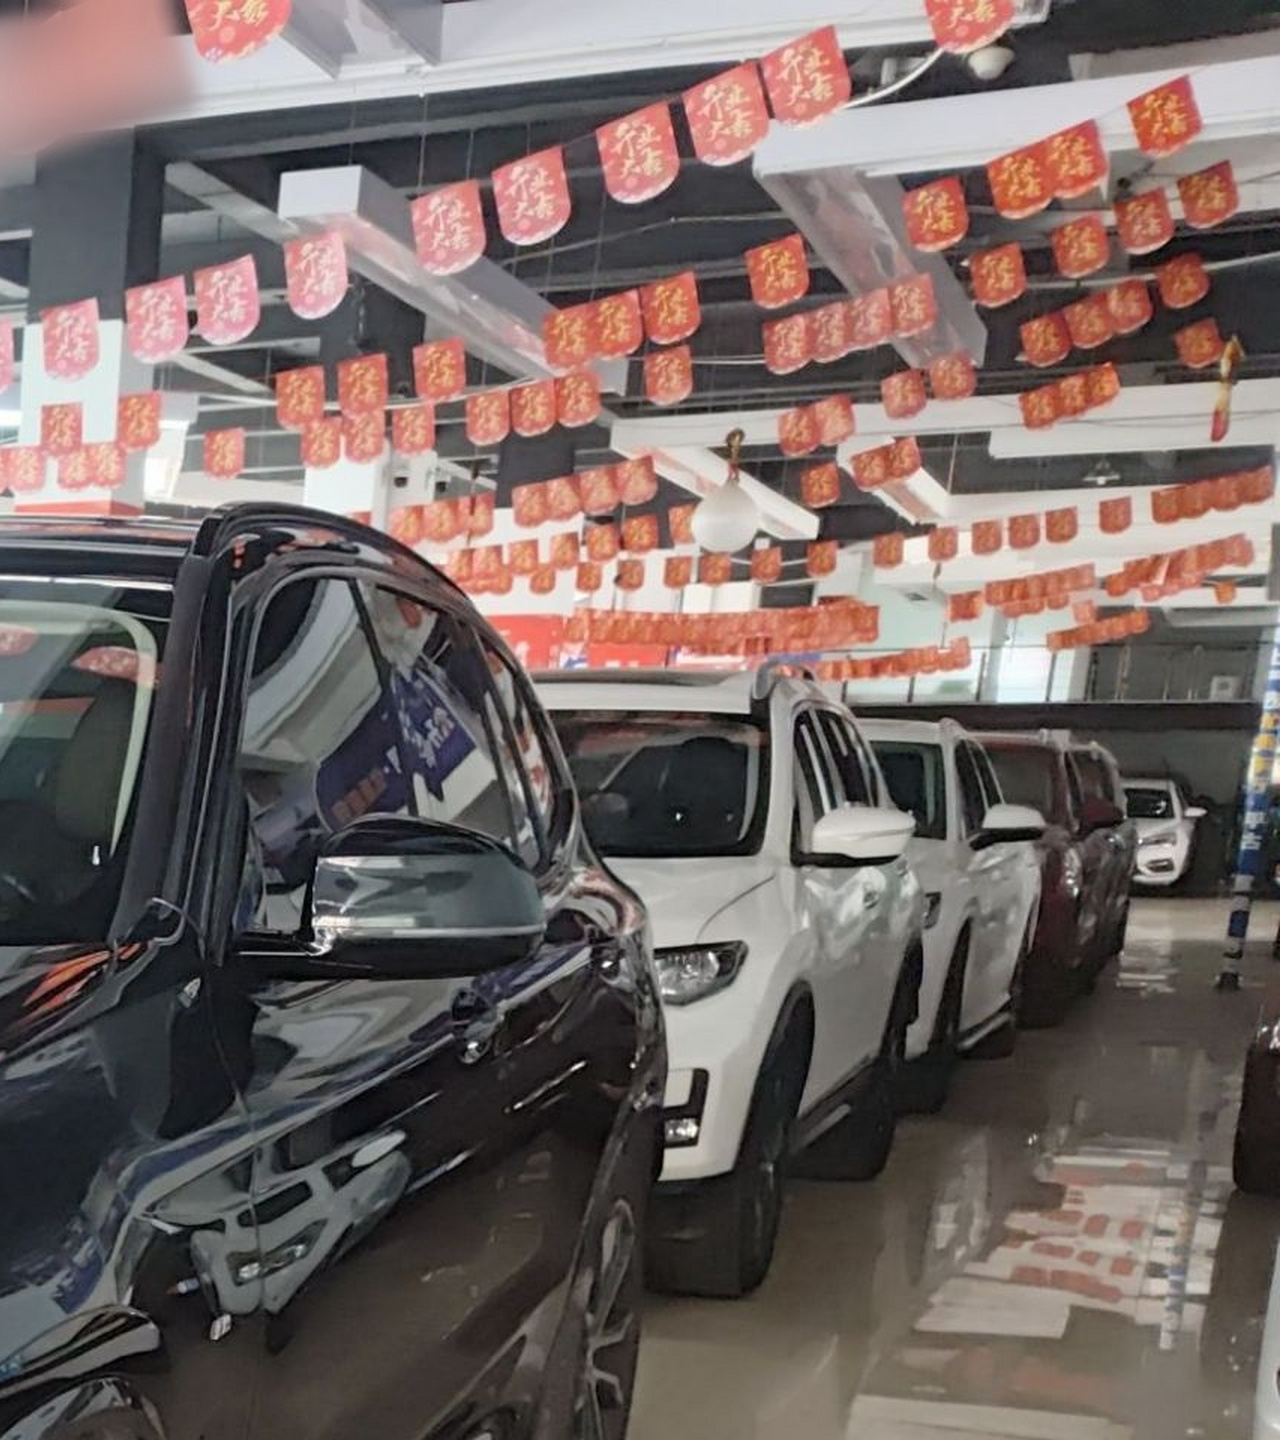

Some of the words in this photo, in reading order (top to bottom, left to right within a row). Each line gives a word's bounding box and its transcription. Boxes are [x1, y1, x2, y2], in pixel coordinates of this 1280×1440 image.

[778, 45, 830, 84] 开业
[700, 81, 750, 122] 开业
[786, 72, 836, 106] 大吉
[613, 120, 662, 162] 开业
[710, 108, 754, 141] 大吉
[622, 148, 664, 179] 大吉
[507, 164, 555, 206] 开业
[424, 194, 471, 235] 开业
[515, 191, 556, 225] 大吉
[431, 222, 471, 250] 大吉
